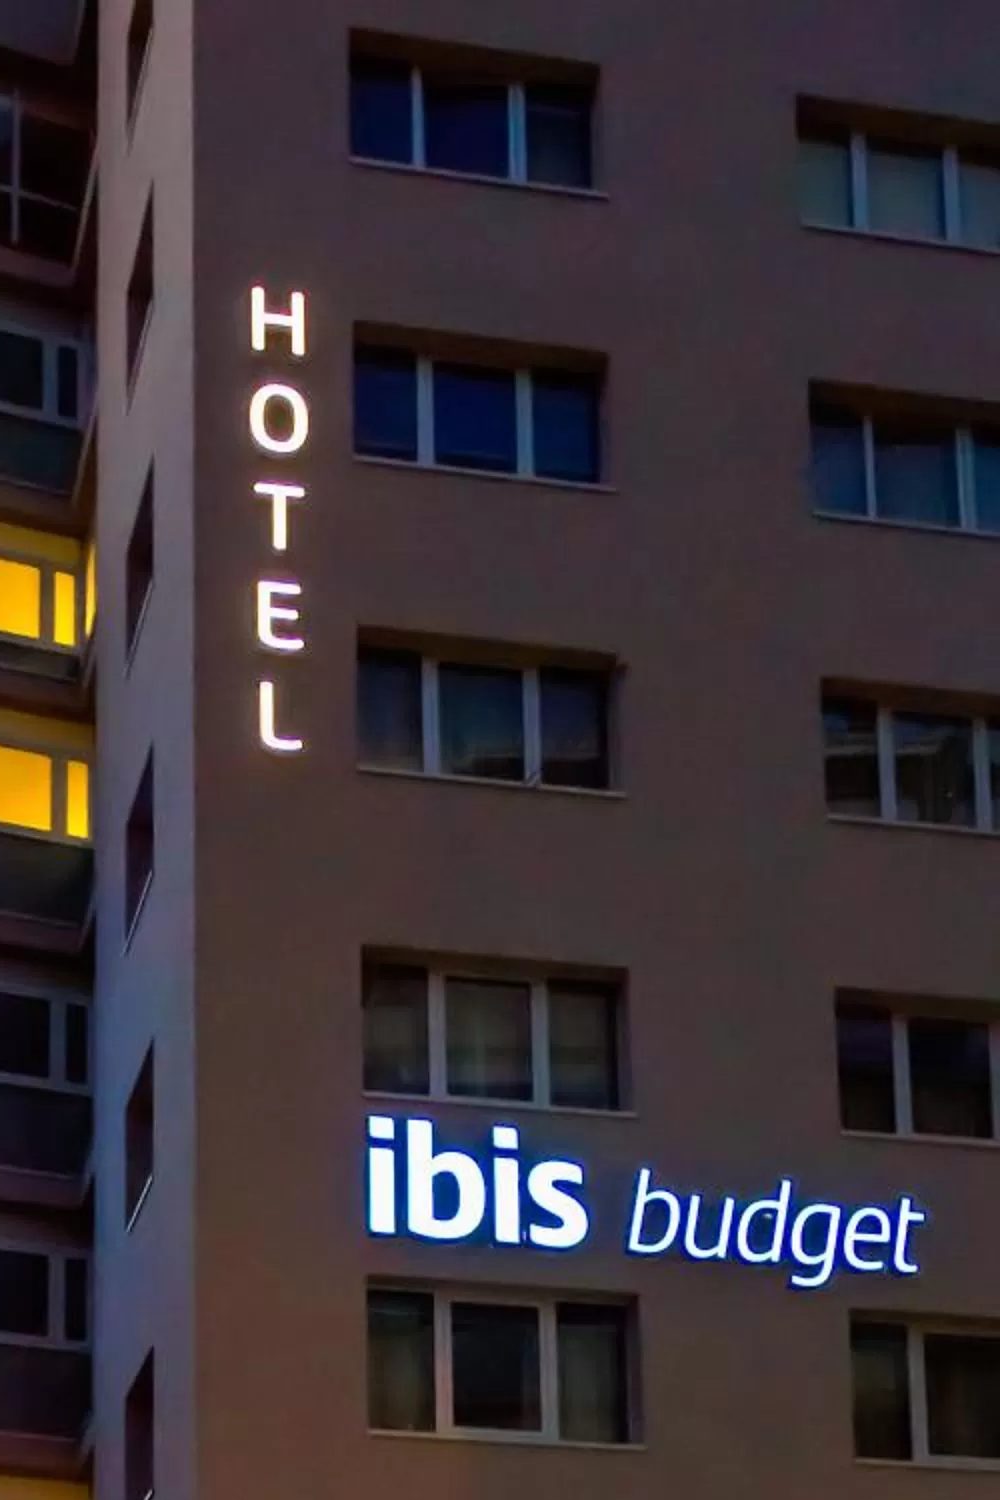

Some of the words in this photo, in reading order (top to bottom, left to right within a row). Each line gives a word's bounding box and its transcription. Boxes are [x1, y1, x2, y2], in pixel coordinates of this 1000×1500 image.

[248, 285, 310, 752] HOTEL
[367, 1115, 590, 1250] ibis
[625, 1167, 926, 1288] budget
